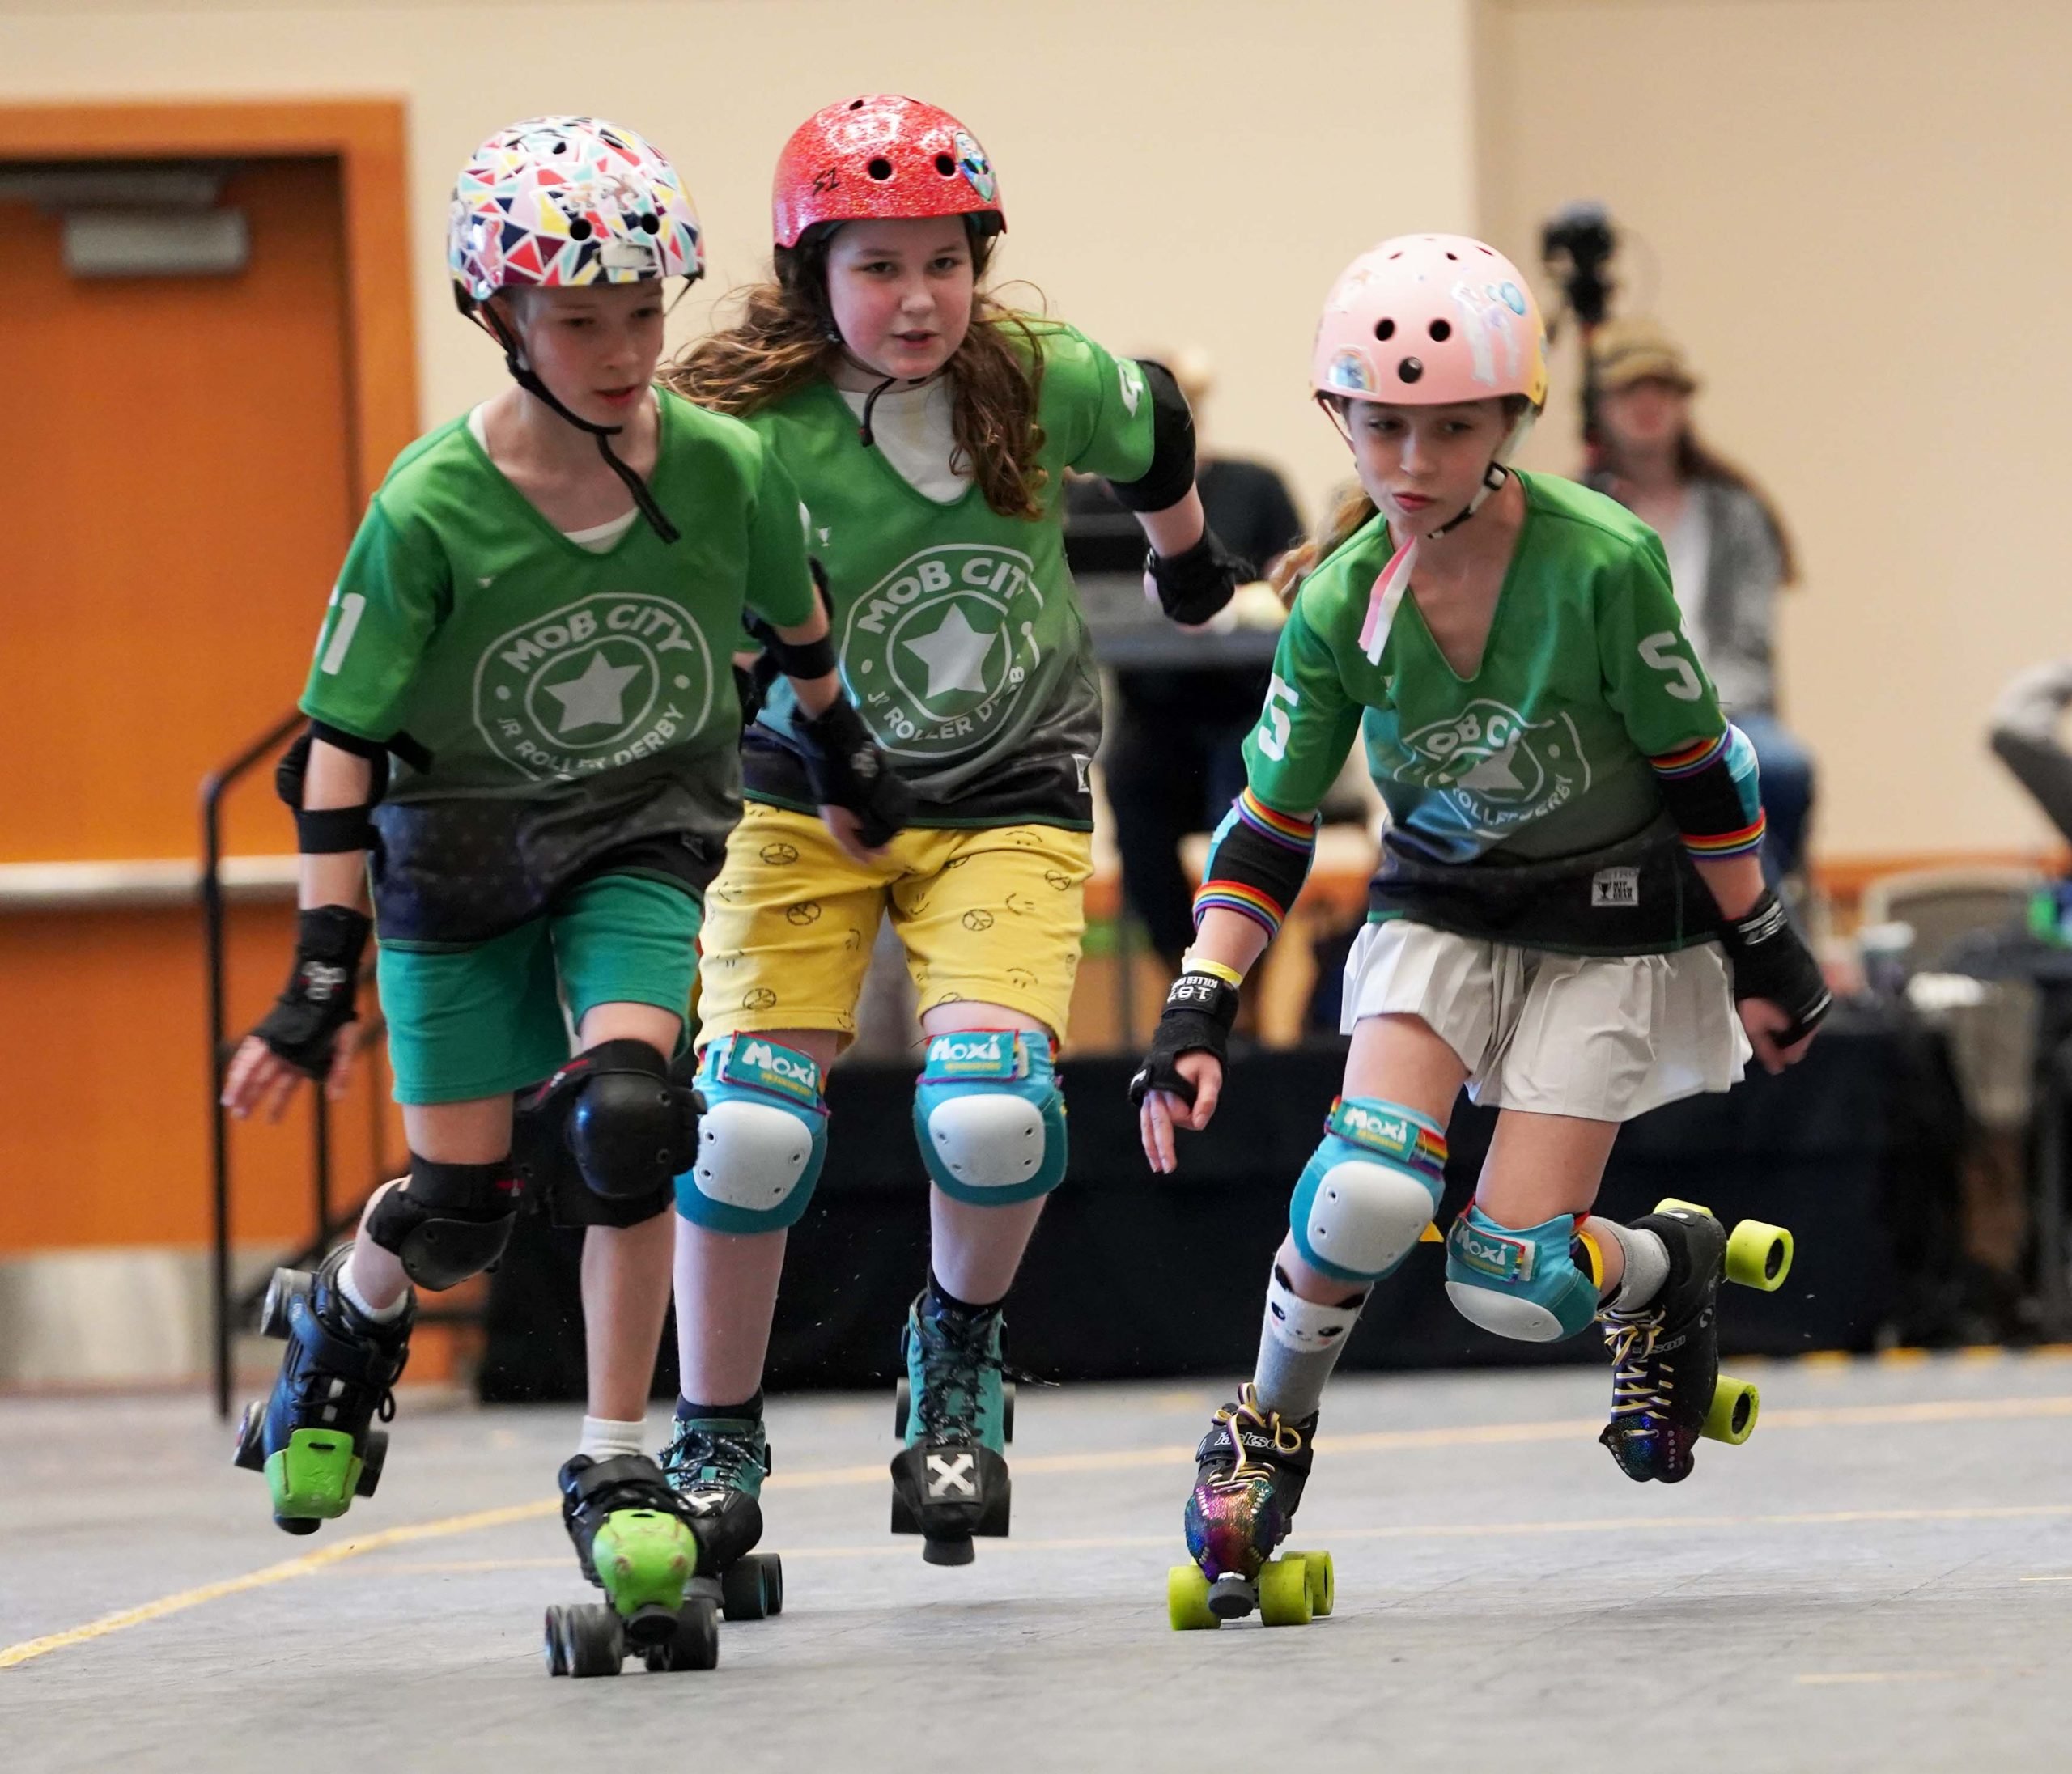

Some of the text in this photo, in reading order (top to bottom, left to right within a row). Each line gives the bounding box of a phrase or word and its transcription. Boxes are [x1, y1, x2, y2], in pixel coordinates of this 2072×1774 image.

[857, 558, 1029, 634] MOB CIT
[500, 604, 694, 673] MOB CITY
[1637, 630, 1702, 701] 5
[497, 717, 522, 738] JR
[613, 702, 685, 766] DERBY
[1258, 671, 1299, 762] 5
[1415, 714, 1481, 762] OB
[741, 1041, 816, 1089] Moxi
[929, 1034, 1001, 1063] Moxi
[1344, 1106, 1407, 1145] Moxi
[1455, 1225, 1508, 1266] Moxi
